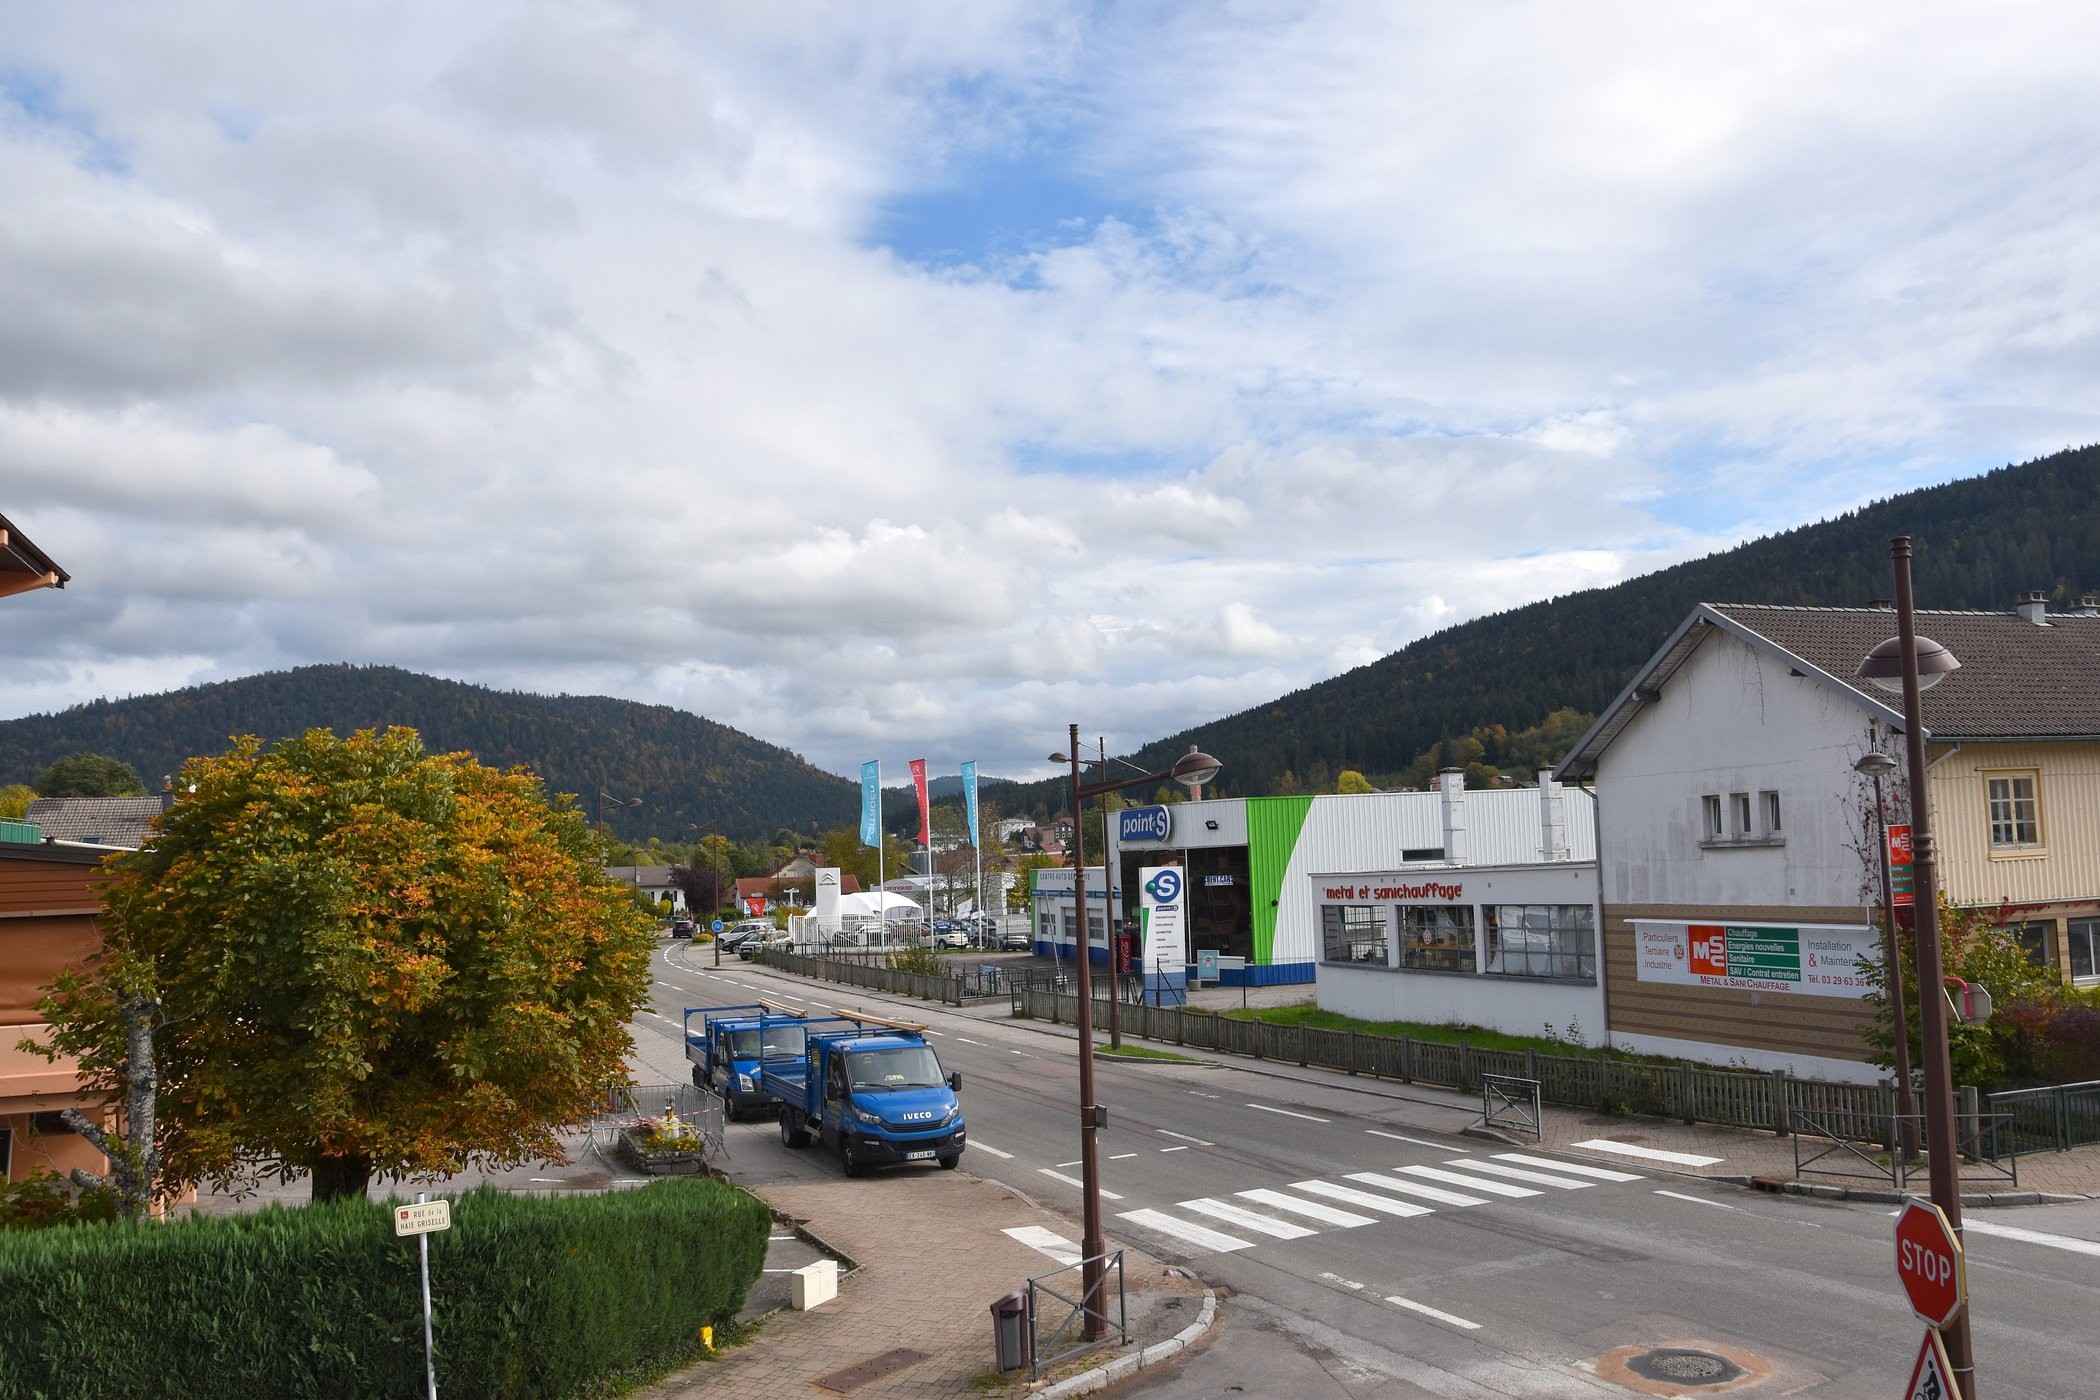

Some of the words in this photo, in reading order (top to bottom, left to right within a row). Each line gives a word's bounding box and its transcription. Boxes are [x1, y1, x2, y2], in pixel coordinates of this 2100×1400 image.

[1326, 885, 1354, 899] metal
[1359, 885, 1370, 899] et
[1374, 882, 1462, 901] sanichauffage
[1728, 929, 1758, 939] Chauffage
[1755, 944, 1784, 952] nouvelles
[1808, 940, 1852, 951] Installation
[1729, 954, 1755, 963] Sanitaire
[1809, 953, 1817, 967] &
[1730, 967, 1742, 976] SAV
[1747, 969, 1770, 978] Contrat
[1771, 970, 1799, 980] entretien
[1822, 976, 1830, 984] 03
[1833, 976, 1841, 985] 29
[1844, 977, 1853, 986] 63
[1856, 978, 1864, 986] 36
[903, 1112, 932, 1120] IVECO
[414, 1210, 425, 1218] RUE
[418, 1217, 445, 1227] GRISELLE
[1902, 1238, 1951, 1287] STOP
